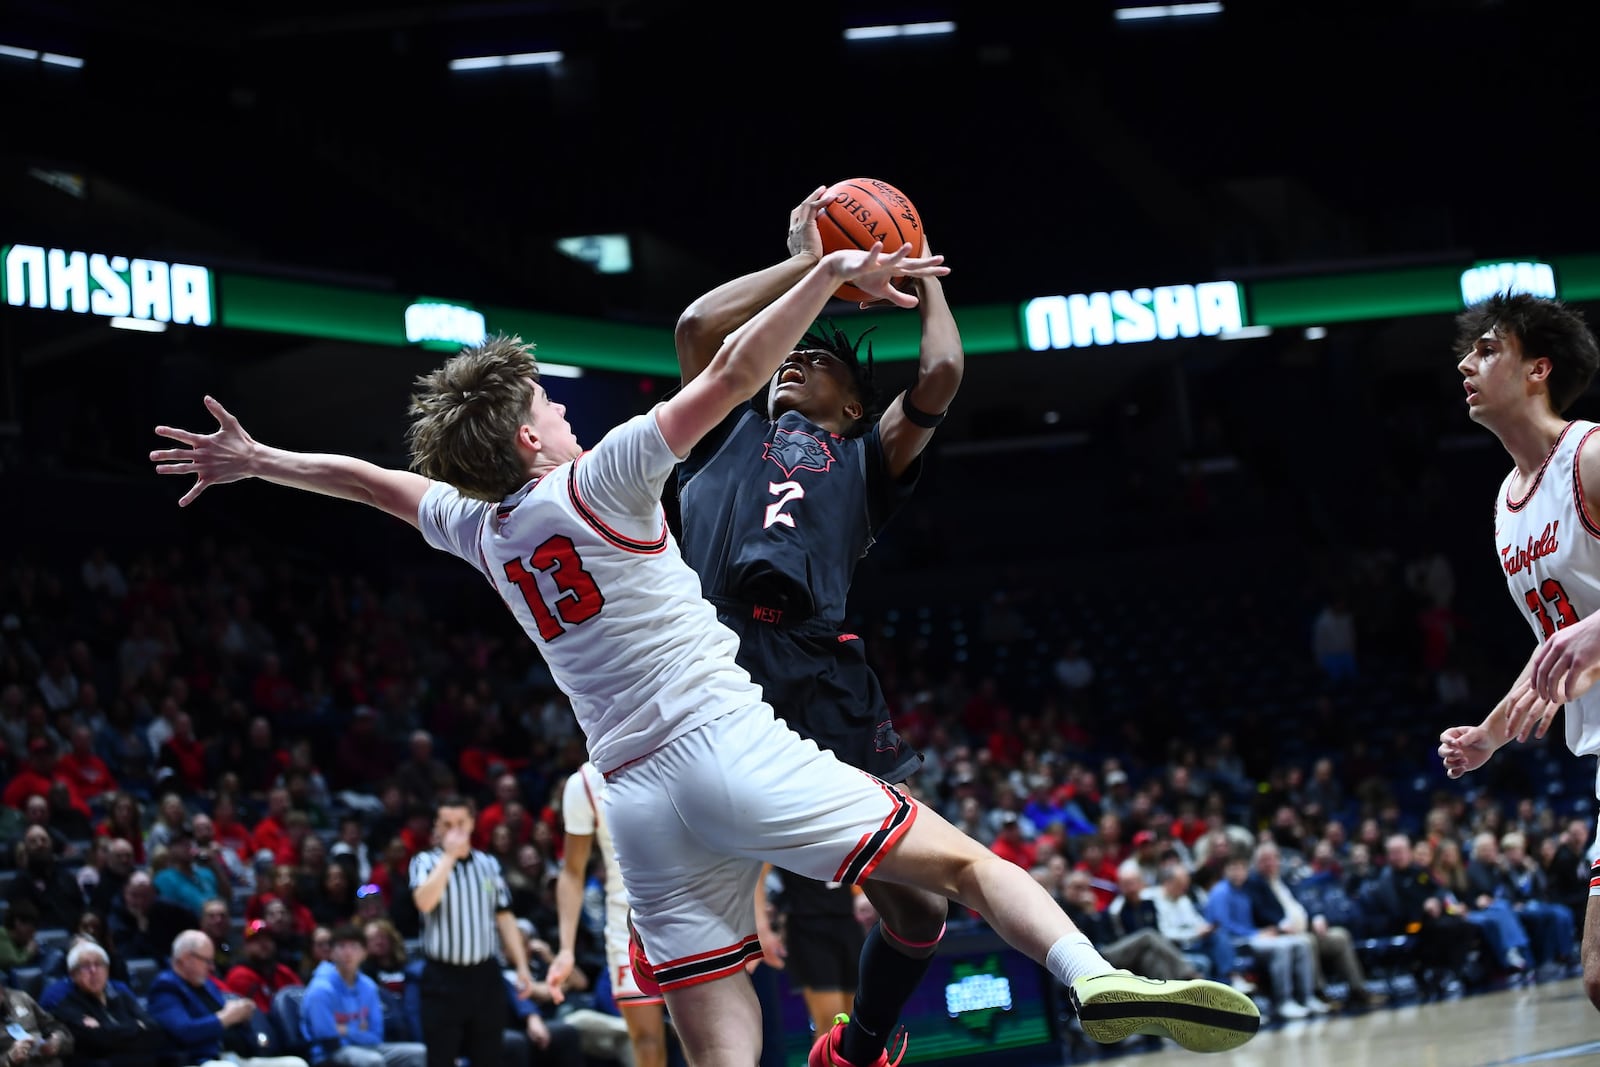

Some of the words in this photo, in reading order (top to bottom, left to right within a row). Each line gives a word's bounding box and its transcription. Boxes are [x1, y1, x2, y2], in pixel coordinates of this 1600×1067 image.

[834, 192, 887, 243] OHSAA
[763, 480, 805, 529] 2
[1501, 519, 1559, 576] Fairfield
[503, 533, 605, 643] 13
[752, 604, 783, 625] WEST
